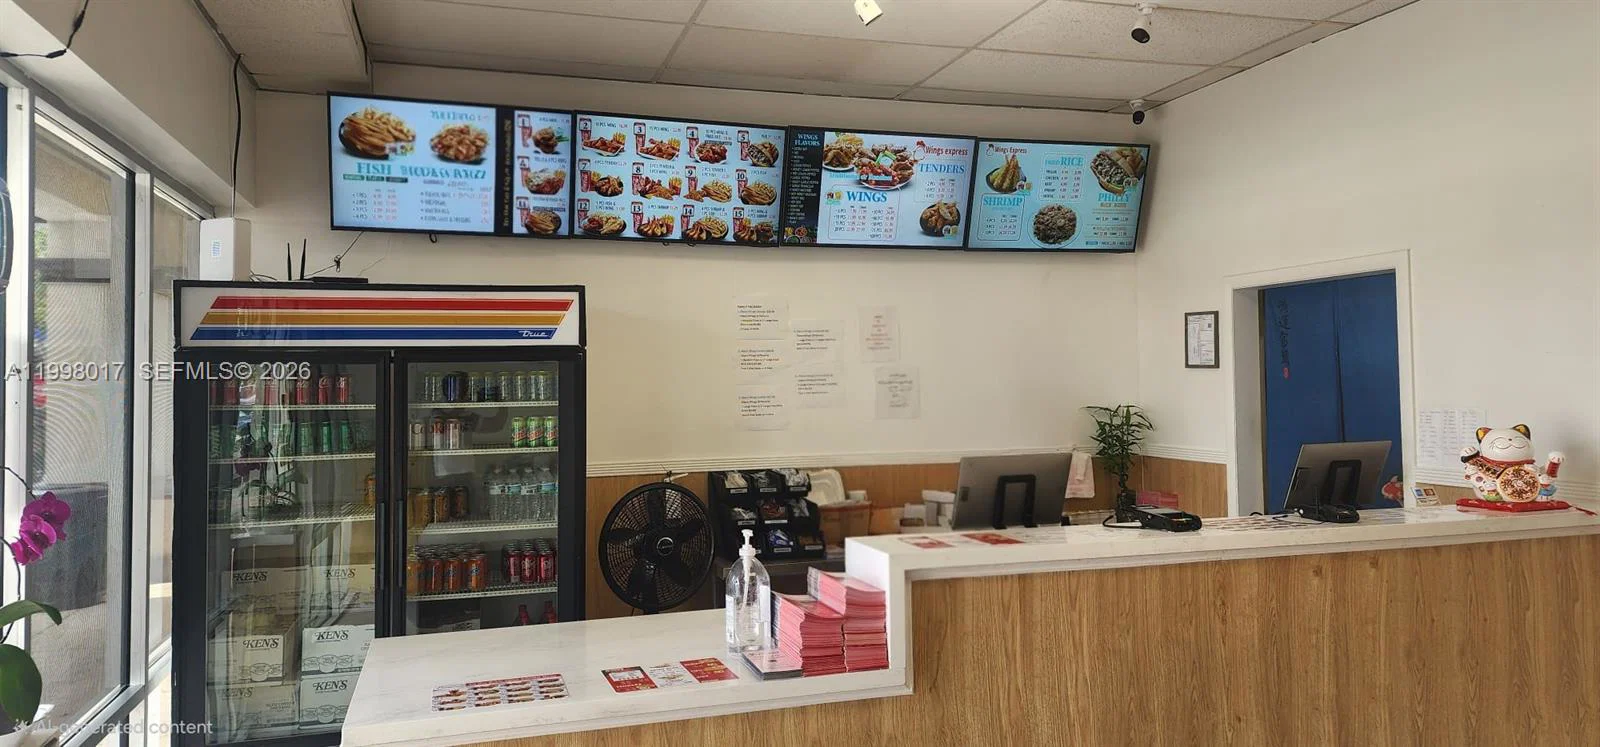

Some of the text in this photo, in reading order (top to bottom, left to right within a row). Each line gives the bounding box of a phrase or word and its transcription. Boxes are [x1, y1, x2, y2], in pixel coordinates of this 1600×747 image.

[925, 146, 968, 157] Wings express
[1061, 157, 1084, 166] RICE
[356, 162, 392, 176] FISH
[919, 163, 965, 174] TENDERS
[847, 191, 887, 203] WINGS
[983, 196, 1023, 206] SHRIMP
[518, 330, 549, 338] True
[325, 568, 356, 580] KEN'S
[314, 630, 349, 642] KEN'S
[242, 638, 279, 650] KEN'S
[312, 680, 347, 693] KEN'S
